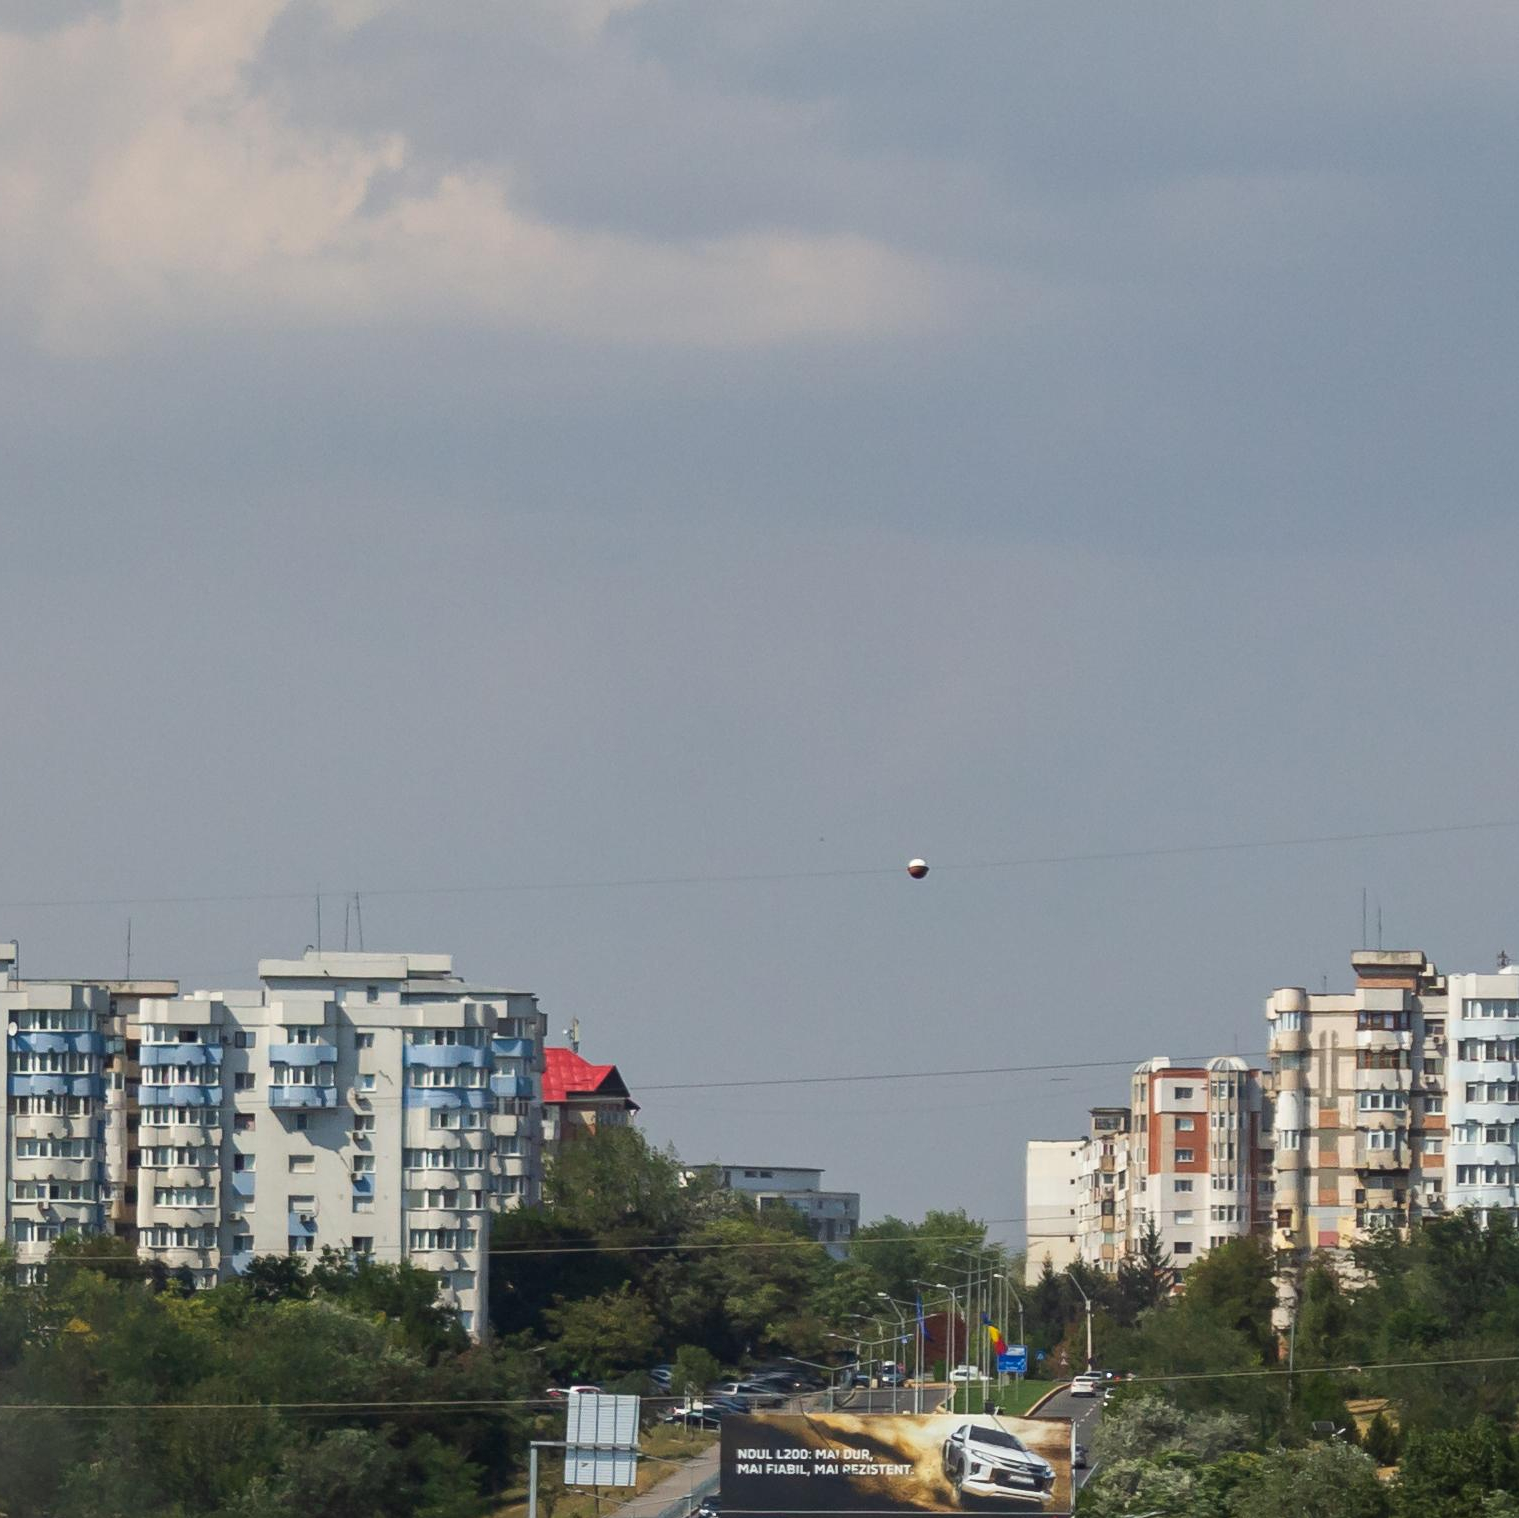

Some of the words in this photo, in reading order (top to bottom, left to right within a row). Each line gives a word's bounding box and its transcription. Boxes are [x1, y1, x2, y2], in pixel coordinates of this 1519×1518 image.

[737, 1448, 773, 1460] NOUL
[776, 1448, 812, 1460] L200:
[815, 1448, 839, 1460] MAI
[843, 1448, 874, 1462] DUR,
[737, 1463, 762, 1475] MAI
[766, 1463, 810, 1477] FIABIL,
[814, 1463, 838, 1475] MAI
[842, 1463, 914, 1475] REZISTENT.
